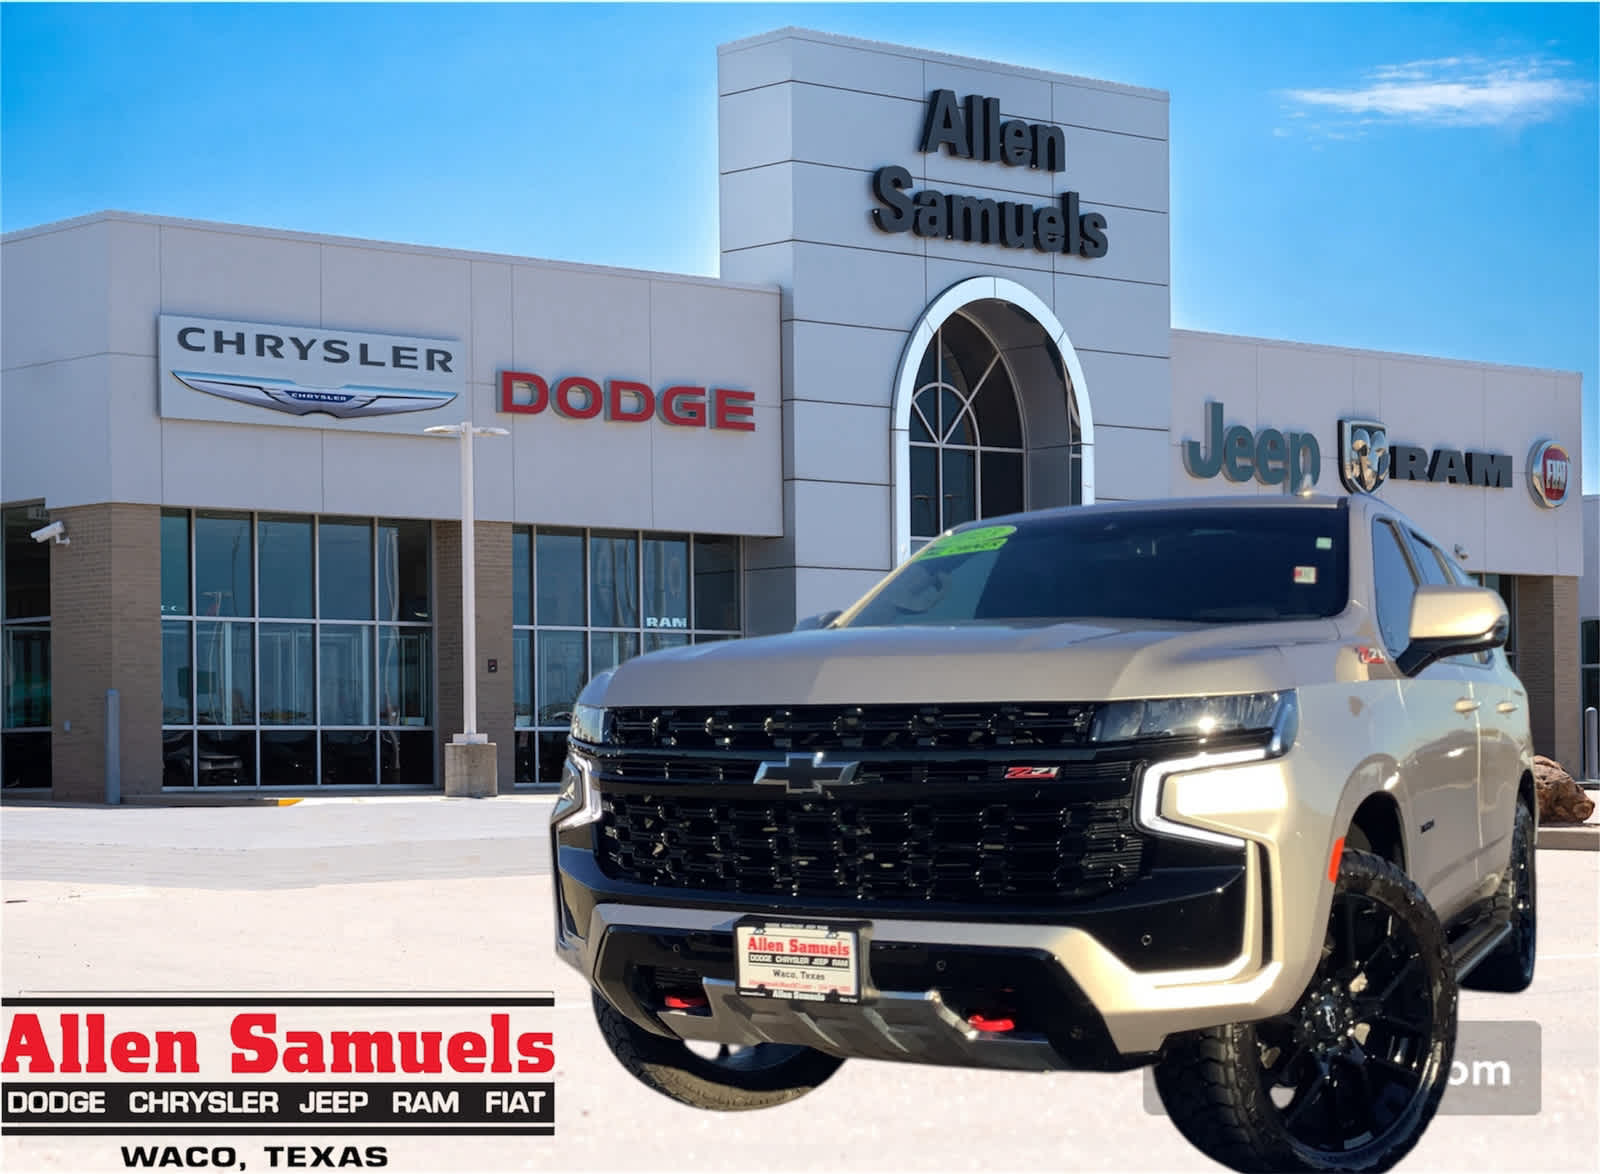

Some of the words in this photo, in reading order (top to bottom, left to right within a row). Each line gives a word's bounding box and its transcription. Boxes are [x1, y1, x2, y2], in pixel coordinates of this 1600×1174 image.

[918, 88, 1066, 172] Allen
[871, 165, 1109, 258] Samuels
[177, 326, 454, 373] CHRYSLER
[495, 370, 756, 432] DODGE
[1181, 401, 1321, 497] Jeep
[1389, 446, 1513, 488] RAM
[1546, 459, 1567, 489] FIAT
[646, 616, 688, 628] RAM
[1004, 766, 1059, 779] Z71
[748, 936, 784, 952] Allen
[789, 938, 850, 957] Samuels
